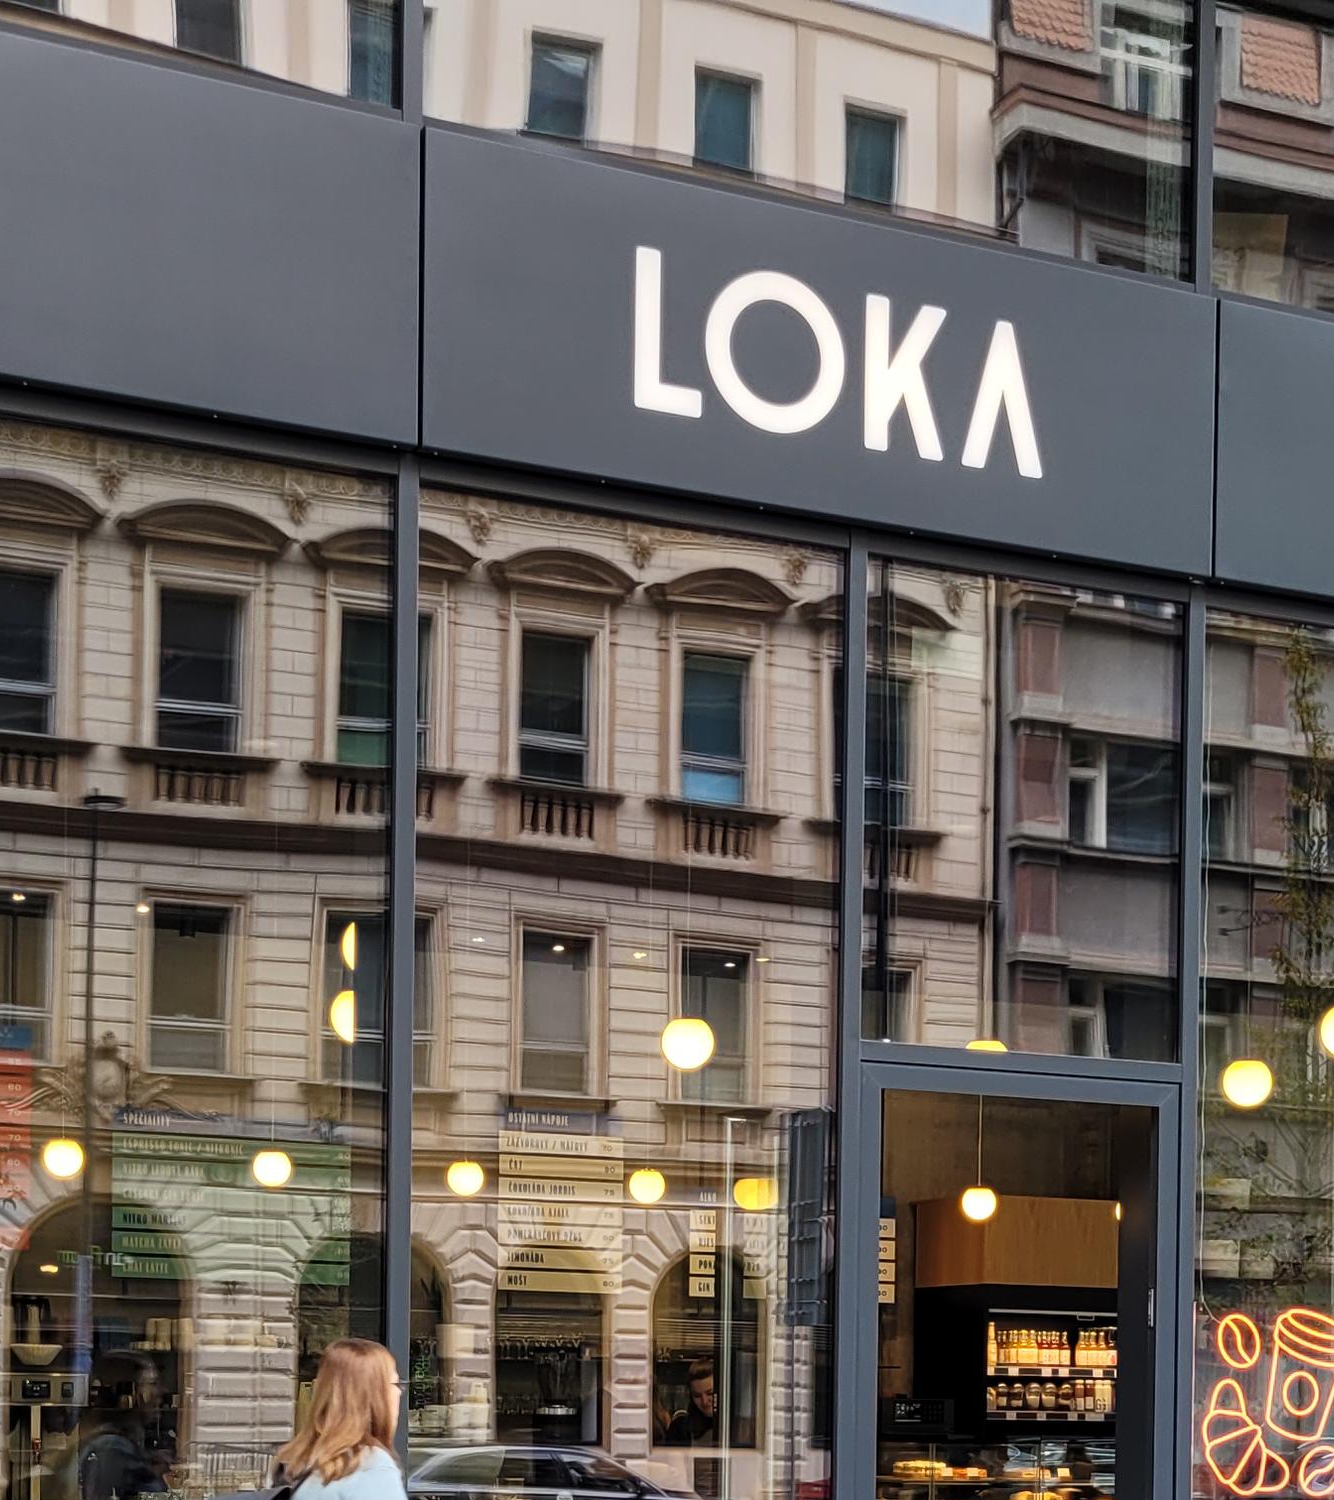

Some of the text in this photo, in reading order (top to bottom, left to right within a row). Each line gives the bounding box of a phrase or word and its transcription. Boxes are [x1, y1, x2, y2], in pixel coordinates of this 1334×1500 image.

[634, 246, 1043, 478] LOKA
[508, 1111, 569, 1127] OSTATNÍ NÁPOJE
[508, 1251, 545, 1263] LIMONÁDA
[507, 1274, 527, 1286] MOŠT
